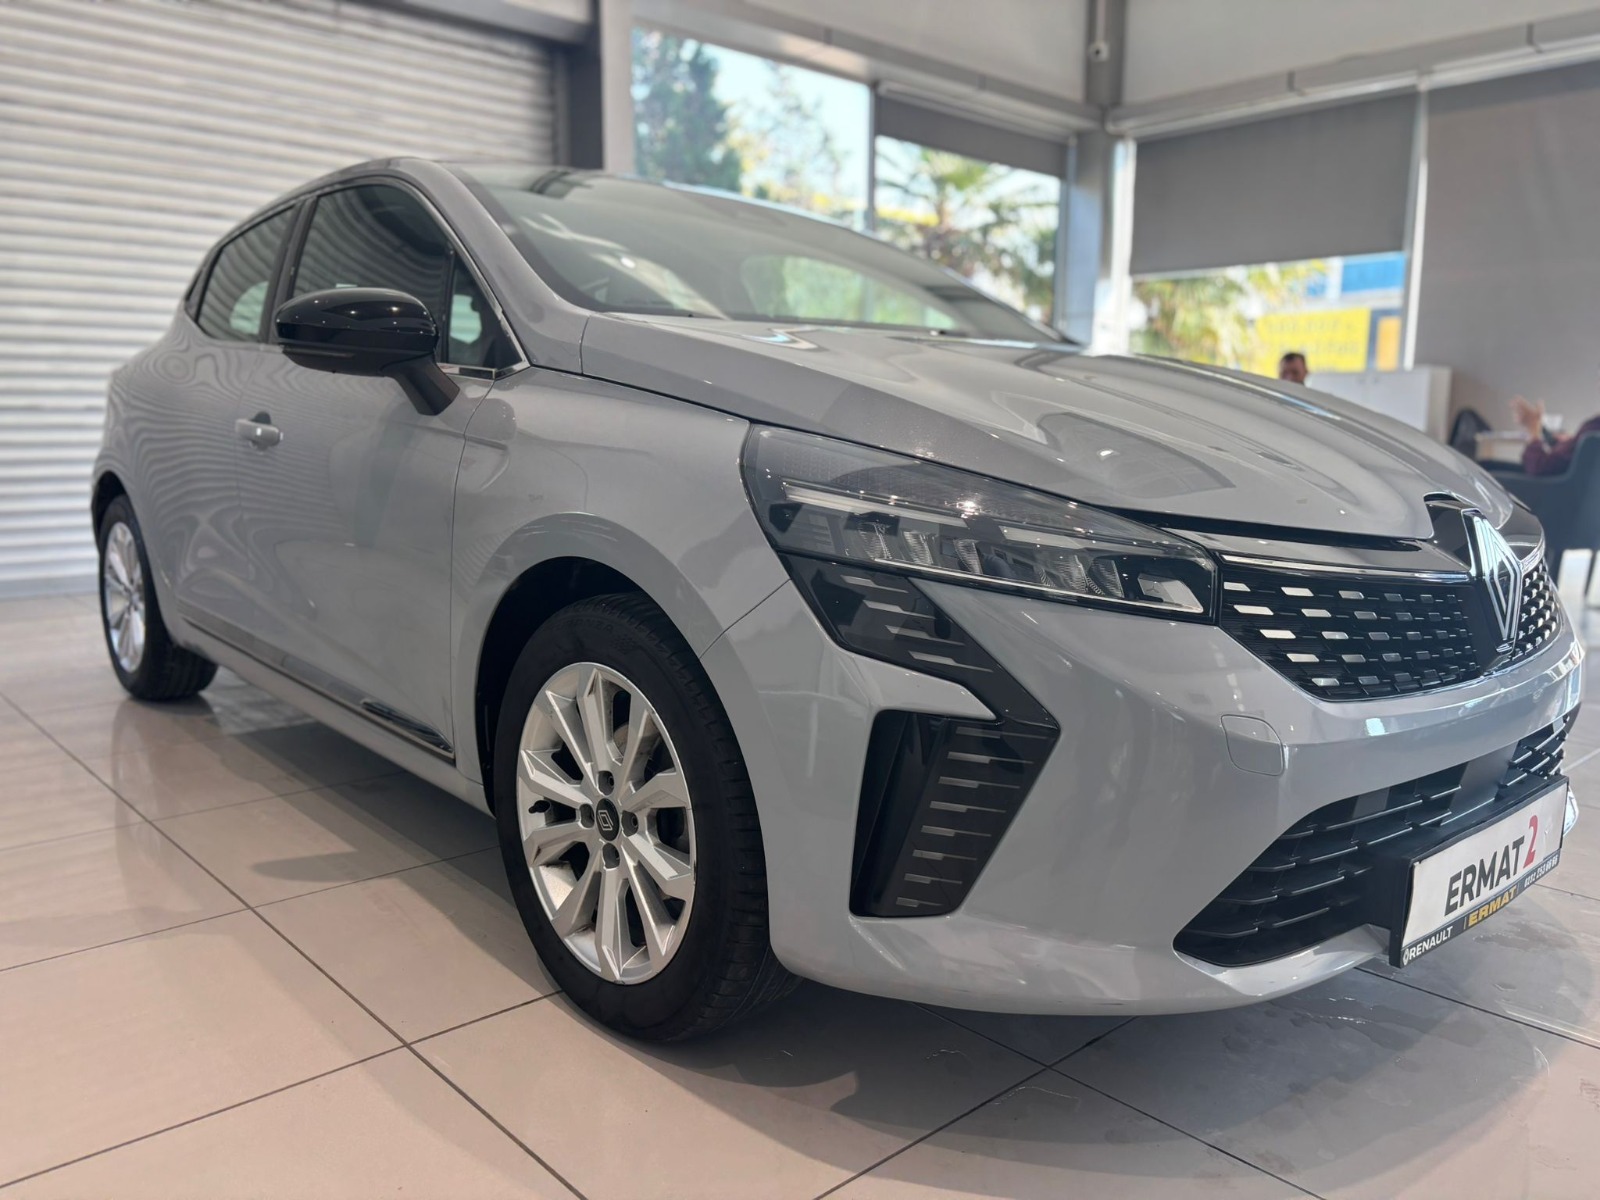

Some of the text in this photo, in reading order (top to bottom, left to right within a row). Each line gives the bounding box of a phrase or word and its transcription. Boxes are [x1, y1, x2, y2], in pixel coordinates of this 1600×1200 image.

[1444, 815, 1538, 916] ERMAT 2
[1468, 885, 1517, 927] ERMAT
[1409, 926, 1453, 960] RENAULT
